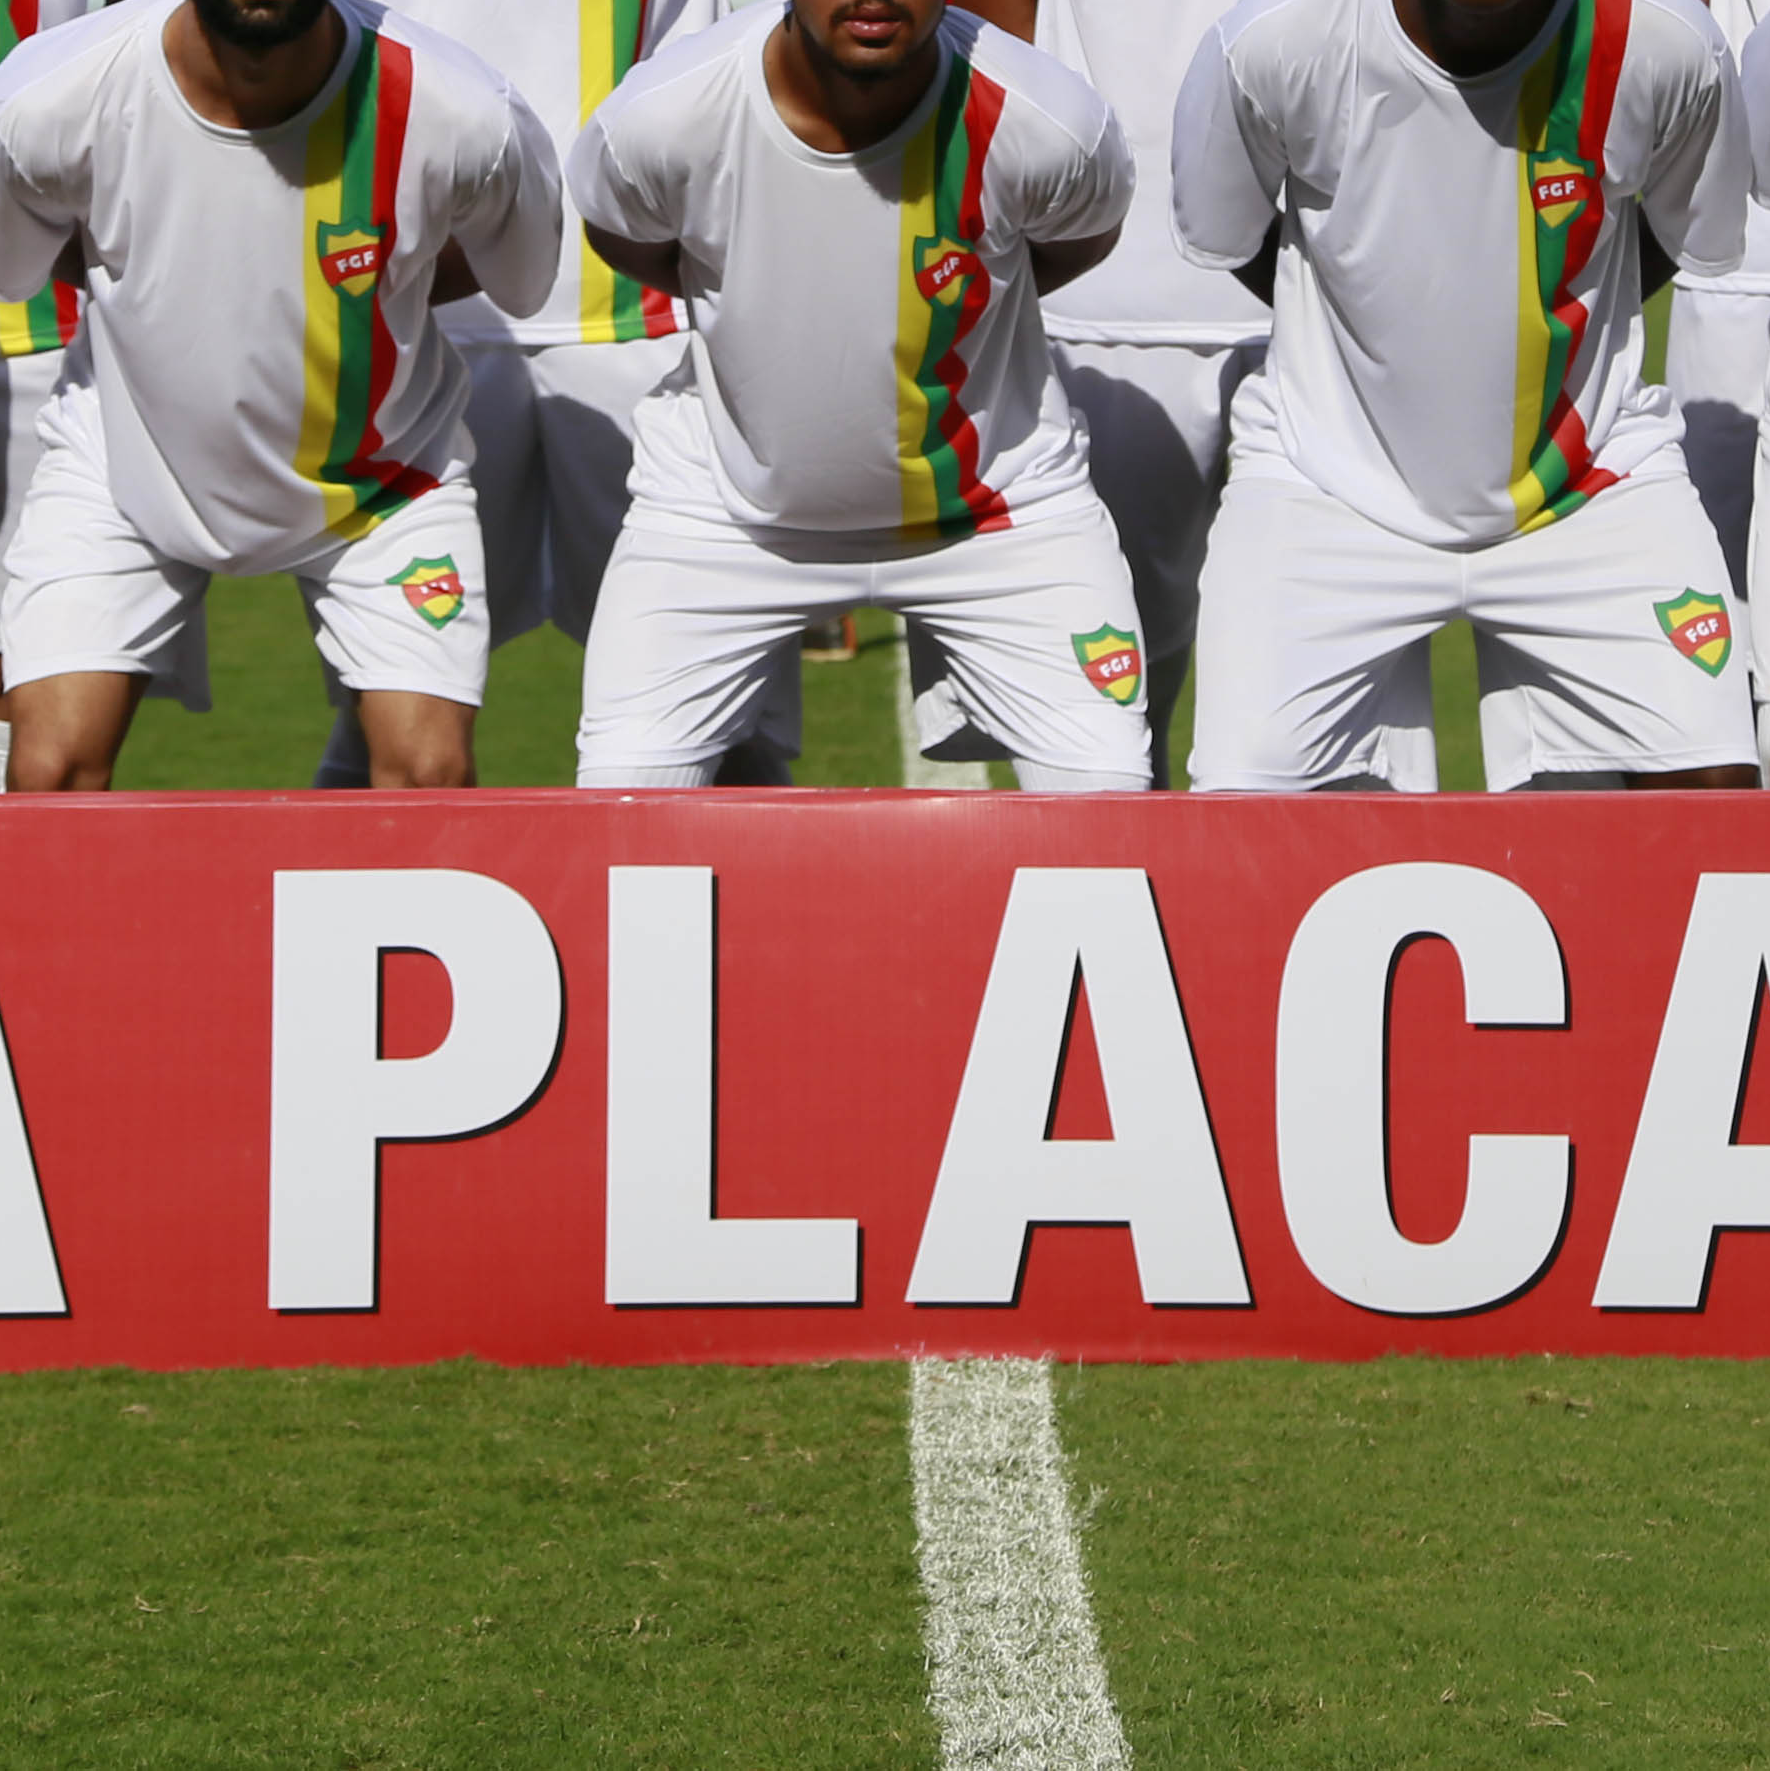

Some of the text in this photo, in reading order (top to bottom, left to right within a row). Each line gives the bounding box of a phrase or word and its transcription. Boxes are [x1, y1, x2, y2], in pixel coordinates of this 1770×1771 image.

[1538, 179, 1576, 201] FGF
[336, 250, 376, 273] FGF
[1684, 618, 1721, 646] FGF
[1099, 654, 1131, 680] FGF
